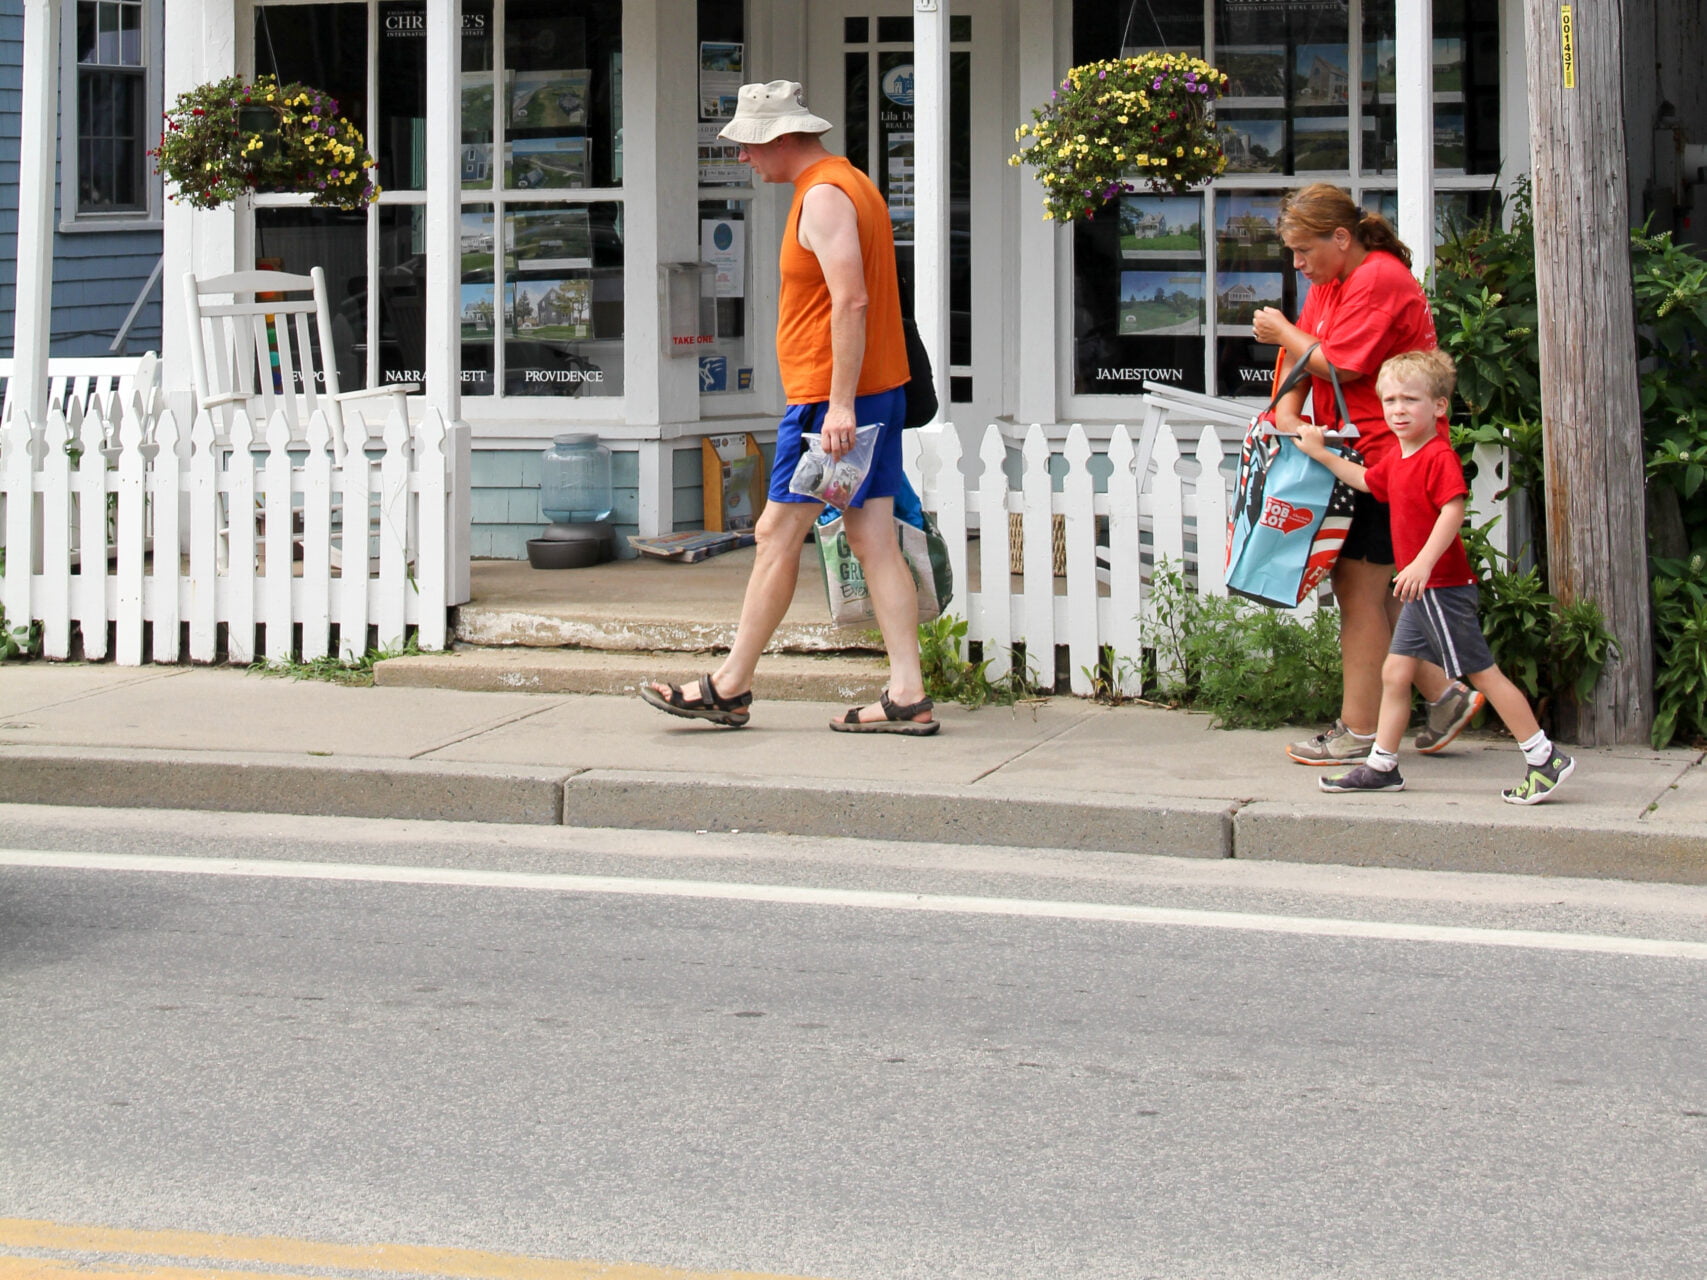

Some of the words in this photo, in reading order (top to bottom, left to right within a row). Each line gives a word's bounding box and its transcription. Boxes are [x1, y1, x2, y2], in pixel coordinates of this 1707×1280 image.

[386, 15, 485, 29] CHRE'S
[1563, 15, 1572, 71] 001437
[881, 111, 898, 121] Lila
[672, 336, 695, 345] TAKE
[696, 335, 714, 344] ONE
[525, 370, 604, 382] PROVIDENCE
[1096, 368, 1183, 381] JAMESTOWN
[1264, 502, 1290, 519] JOB
[1261, 512, 1287, 528] LOT
